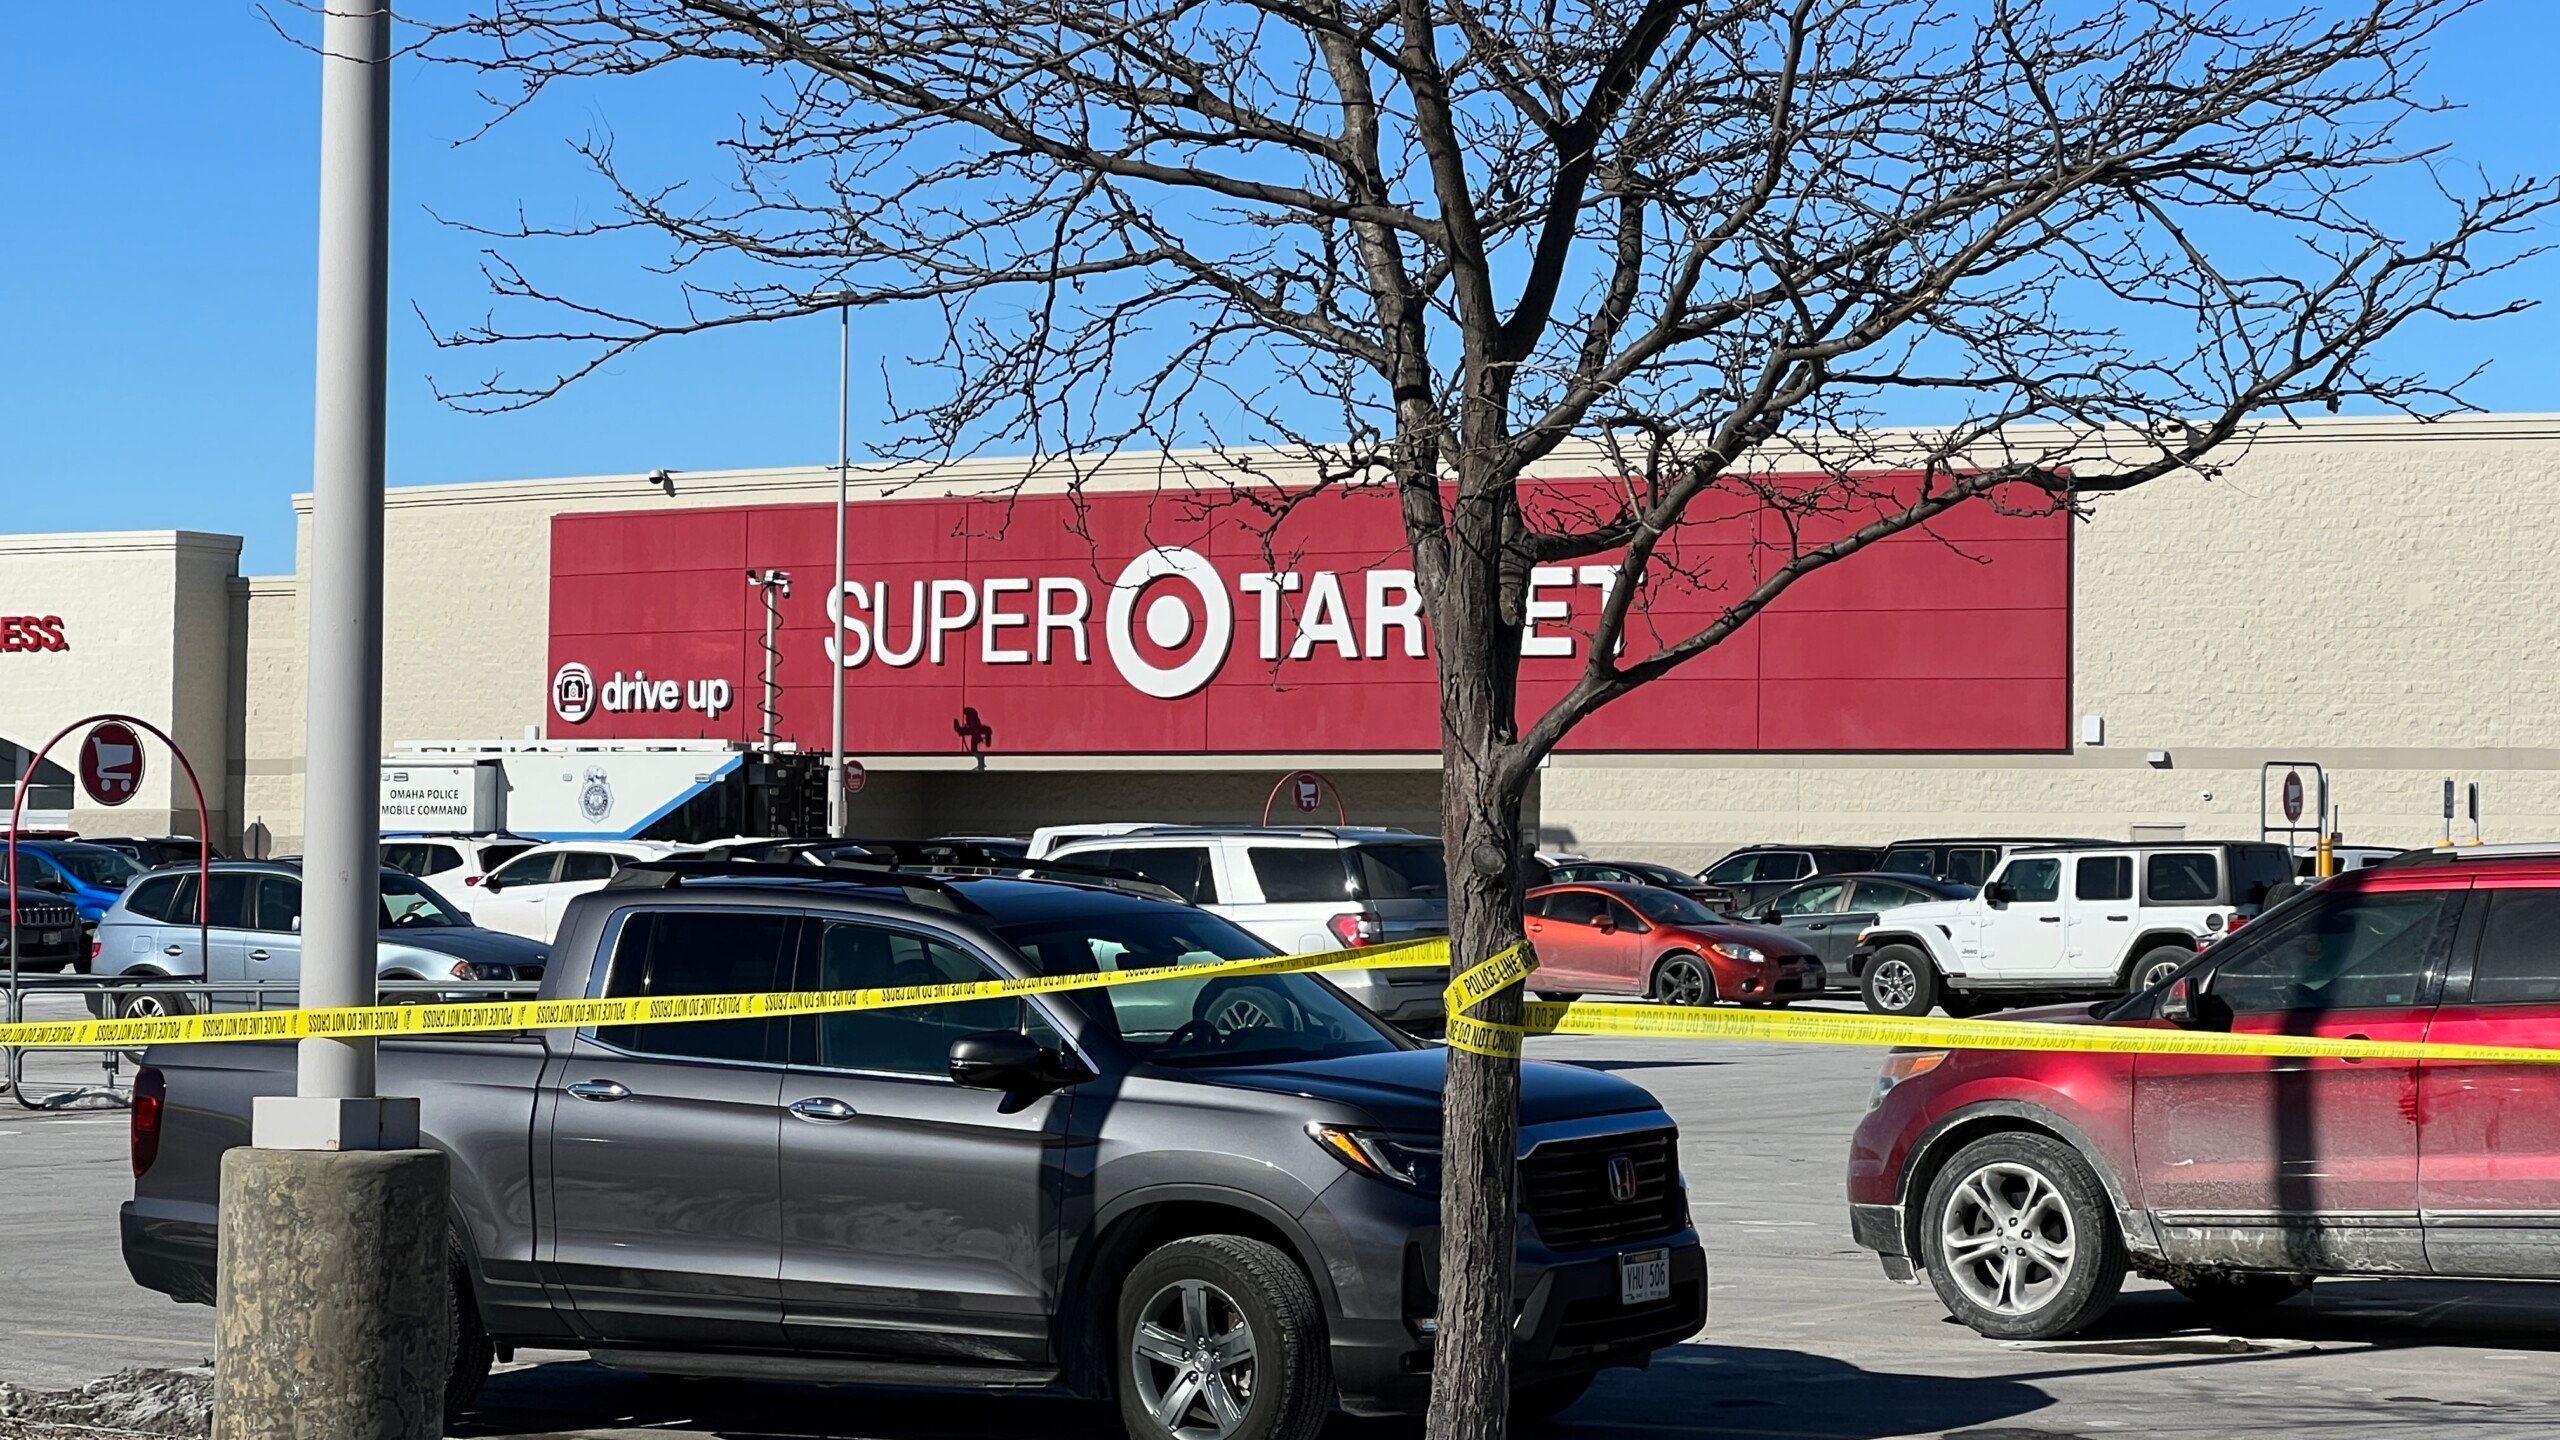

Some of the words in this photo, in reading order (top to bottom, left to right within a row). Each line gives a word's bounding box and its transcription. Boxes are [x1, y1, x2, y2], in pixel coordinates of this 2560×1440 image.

[823, 577, 1089, 667] SUPER
[1239, 565, 1646, 660] TARET
[601, 670, 681, 711] drive
[687, 678, 731, 718] up
[390, 789, 425, 799] OMAHA
[427, 789, 459, 799] POLICE
[381, 805, 416, 815] MOBILE
[417, 805, 468, 816] COMMAND
[1463, 965, 1500, 998] POLICE
[1495, 954, 1522, 980] LINE
[536, 1005, 560, 1024] CROSS
[560, 1004, 575, 1023] NOT
[575, 1004, 586, 1022] DO
[585, 1003, 602, 1022] LINE
[602, 1002, 627, 1021] POLICE
[650, 999, 673, 1019] CROSS
[673, 999, 689, 1017] NOT
[689, 998, 700, 1016] DO
[700, 997, 717, 1016] LINE
[716, 996, 742, 1014] POLICE
[248, 1017, 263, 1035] LINE
[264, 1015, 287, 1035] POLICE
[308, 1013, 331, 1033] CROSS
[332, 1013, 346, 1032] NOT
[347, 1012, 357, 1031] DO
[358, 1012, 373, 1031] LINE
[375, 1011, 399, 1030] POLICE
[422, 1009, 446, 1028] CROSS
[446, 1009, 461, 1027] NOT
[461, 1008, 472, 1027] DO
[472, 1008, 488, 1027] LINE
[488, 1007, 514, 1026] POLICE
[202, 1018, 224, 1037] CROSS
[224, 1018, 238, 1036] NOT
[239, 1017, 248, 1036] DO
[1457, 1022, 1471, 1044] DO
[1472, 1026, 1493, 1049] NOT
[1626, 1265, 1644, 1292] VHU
[1649, 1262, 1666, 1288] 506
